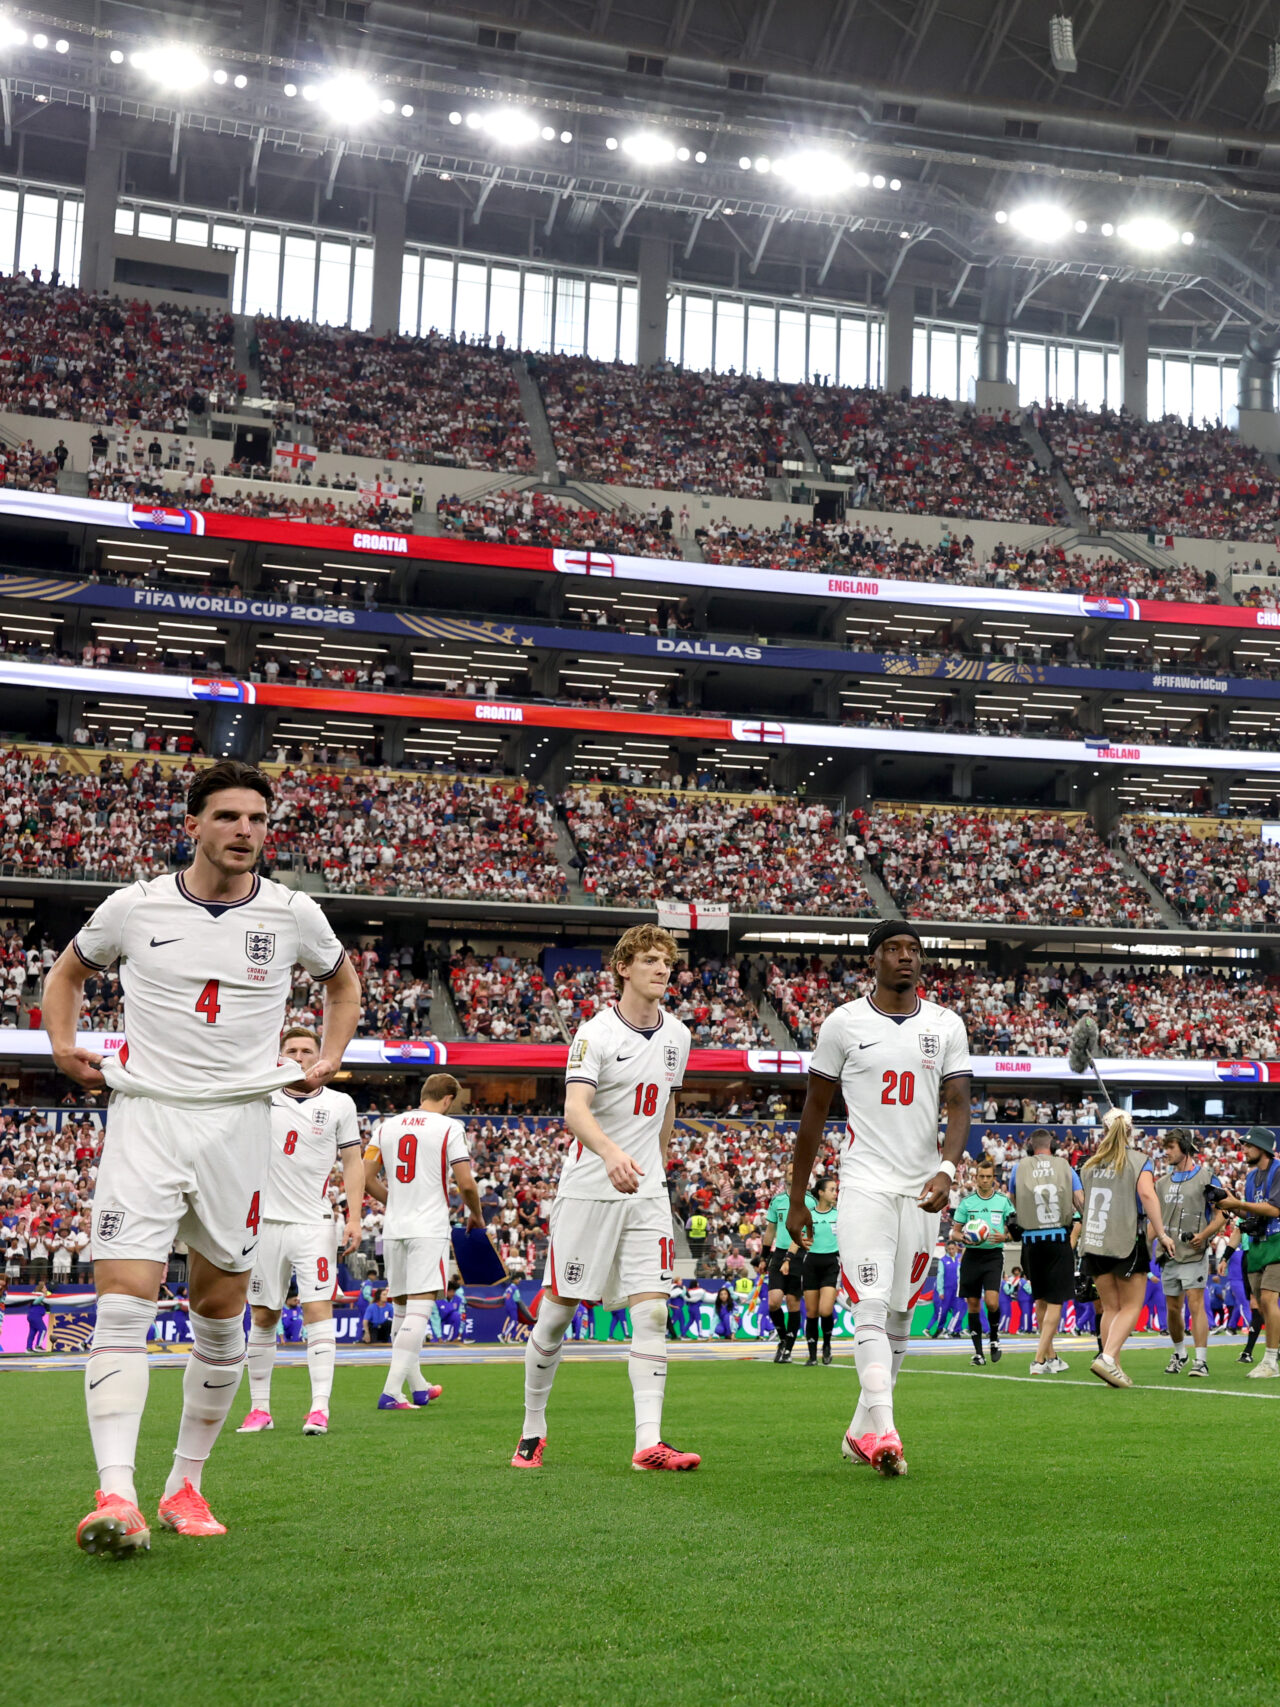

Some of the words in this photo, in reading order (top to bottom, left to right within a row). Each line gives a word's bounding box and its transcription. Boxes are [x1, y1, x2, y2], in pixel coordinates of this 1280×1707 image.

[353, 532, 407, 553] CROATIA
[828, 579, 879, 596] ENGLAND
[134, 590, 177, 608] FIFA
[179, 595, 247, 616] WORLD
[250, 602, 288, 618] CUP
[290, 606, 355, 625] 2026
[657, 639, 761, 660] DALLAS
[1152, 674, 1227, 693] #FIFAWorldCup
[475, 704, 522, 722] CROATIA
[247, 967, 268, 975] CROATIA
[195, 979, 221, 1023] 4
[995, 1062, 1031, 1072] ENGLAND
[633, 1083, 658, 1117] 18
[881, 1070, 915, 1106] 20
[401, 1117, 427, 1127] KANE
[283, 1130, 298, 1155] 8
[396, 1134, 418, 1183] 9
[245, 1190, 260, 1236] 4
[316, 1256, 329, 1282] 8
[911, 1251, 930, 1284] 0
